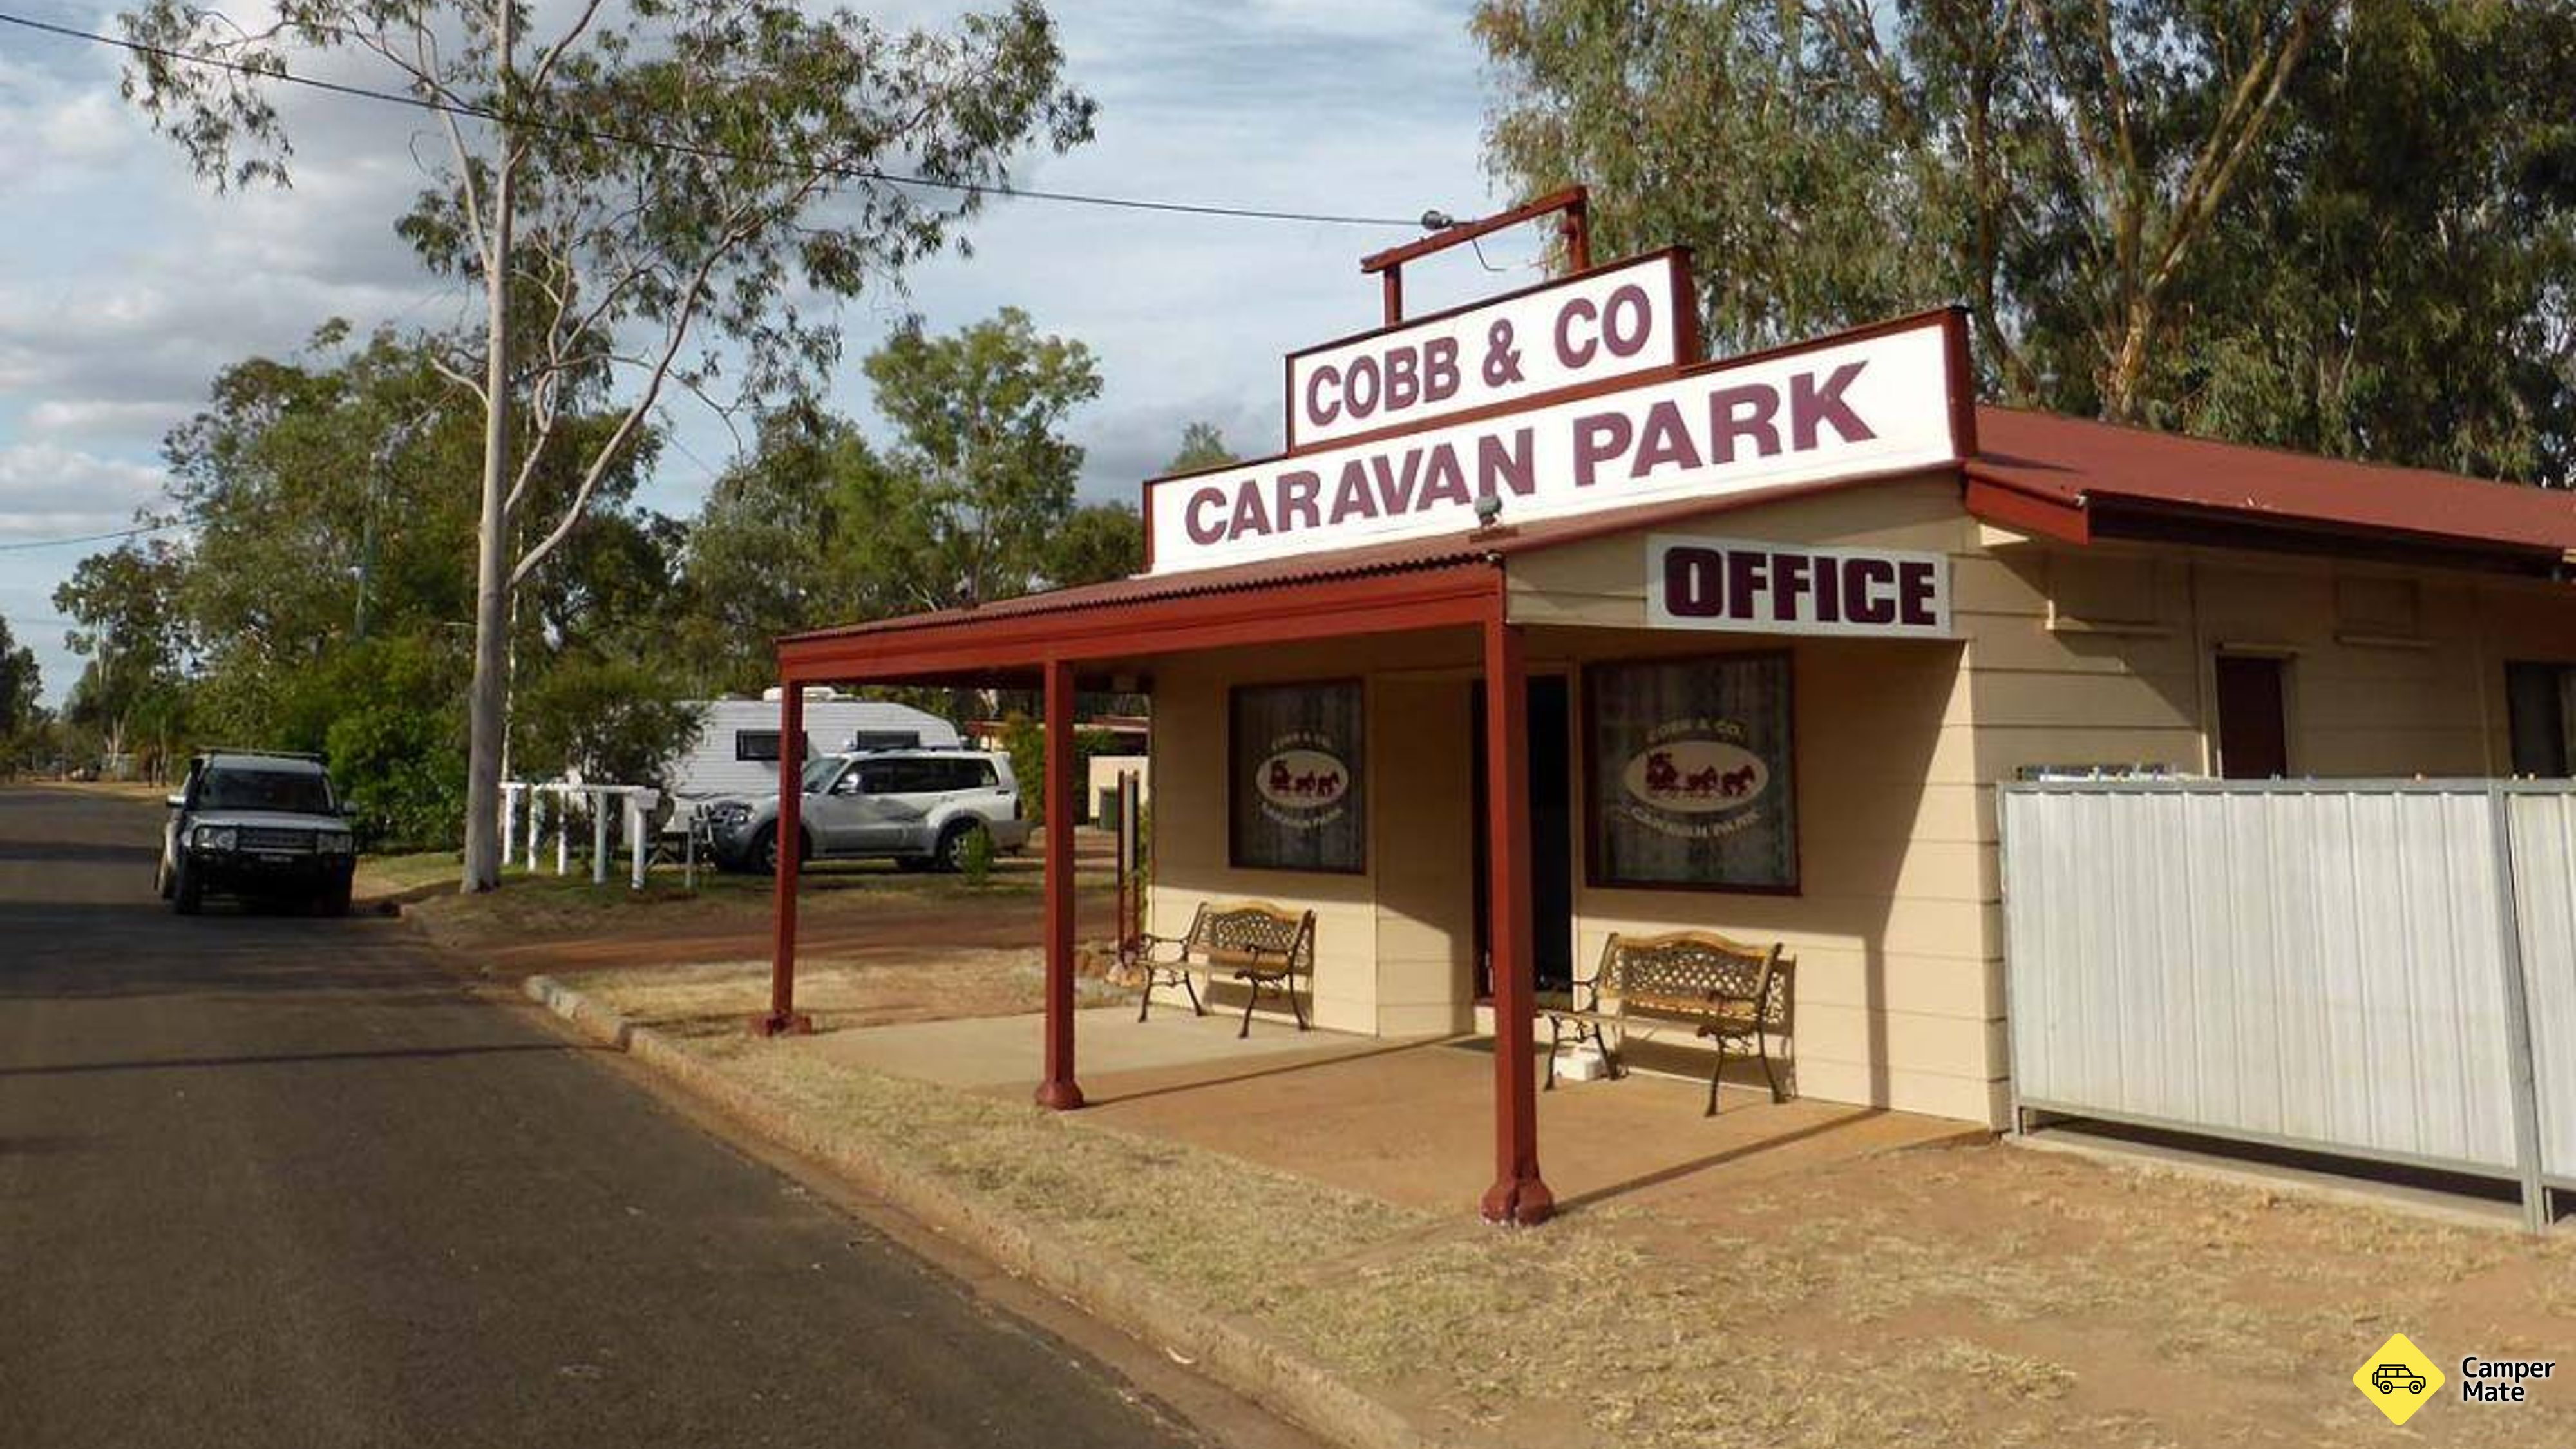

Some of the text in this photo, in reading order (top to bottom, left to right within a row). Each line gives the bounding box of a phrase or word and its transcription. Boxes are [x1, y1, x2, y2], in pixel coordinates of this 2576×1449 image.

[1307, 284, 1652, 426] COBB & CO
[1185, 360, 1877, 545] CARAVAN PARK
[1662, 545, 1937, 627] OFFICE
